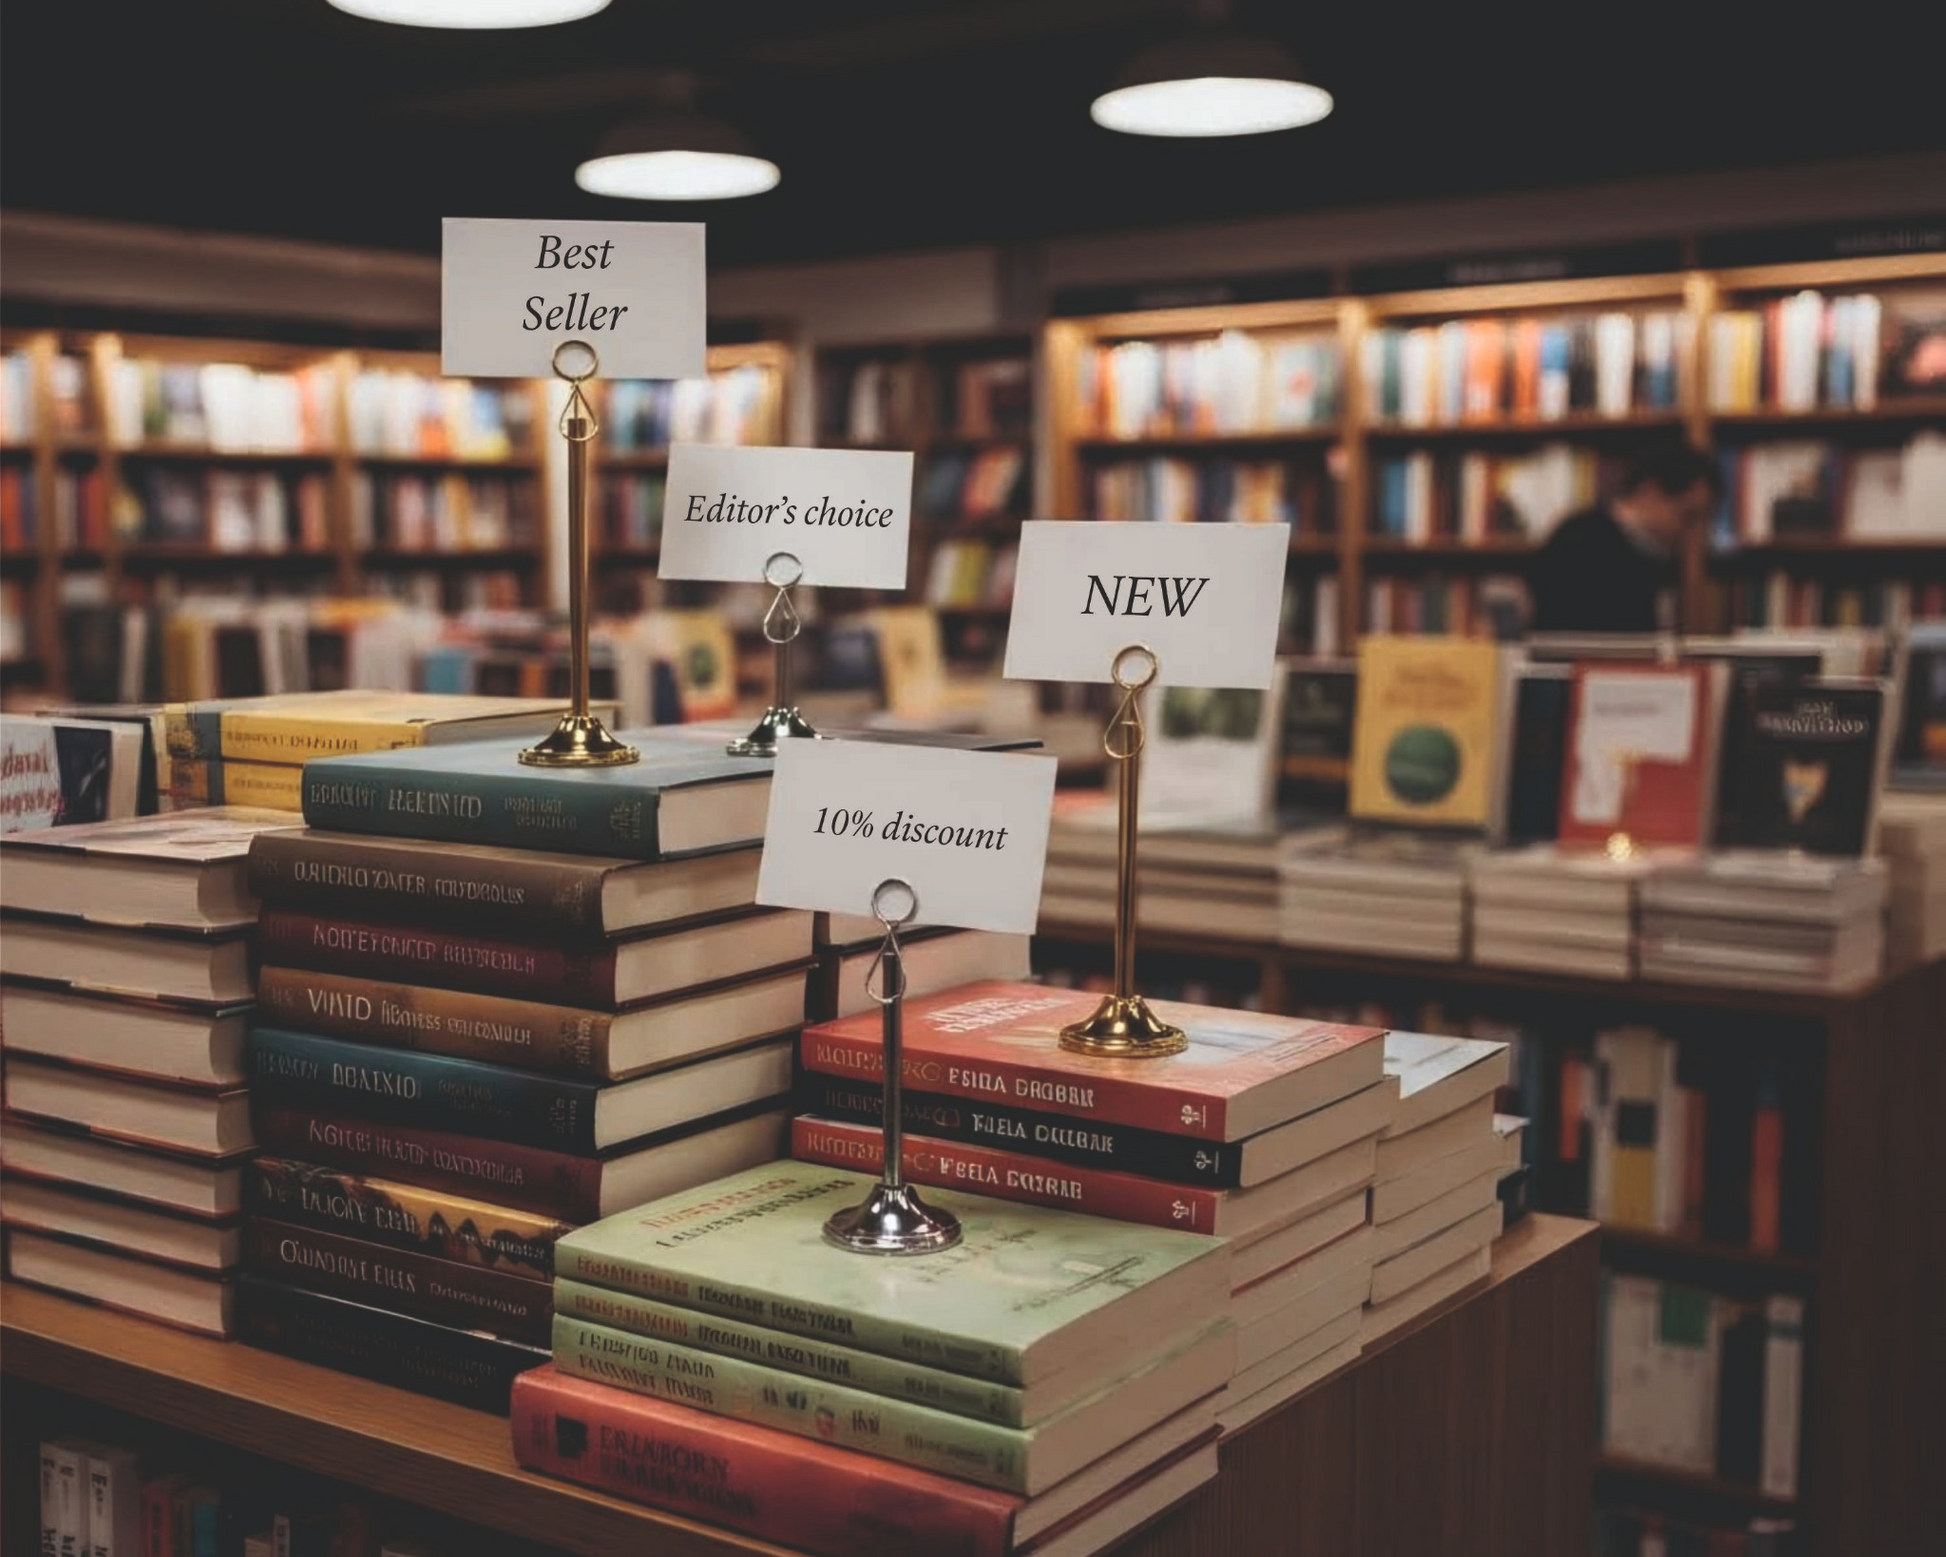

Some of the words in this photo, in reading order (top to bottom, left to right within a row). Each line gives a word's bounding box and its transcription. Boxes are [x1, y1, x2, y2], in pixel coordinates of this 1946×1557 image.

[534, 235, 615, 270] Best
[522, 292, 629, 331] Seller
[683, 492, 797, 525] Editor’s
[804, 496, 894, 528] choice
[1080, 574, 1211, 618] NEW
[813, 807, 875, 838] 10%
[881, 810, 1009, 851] discount
